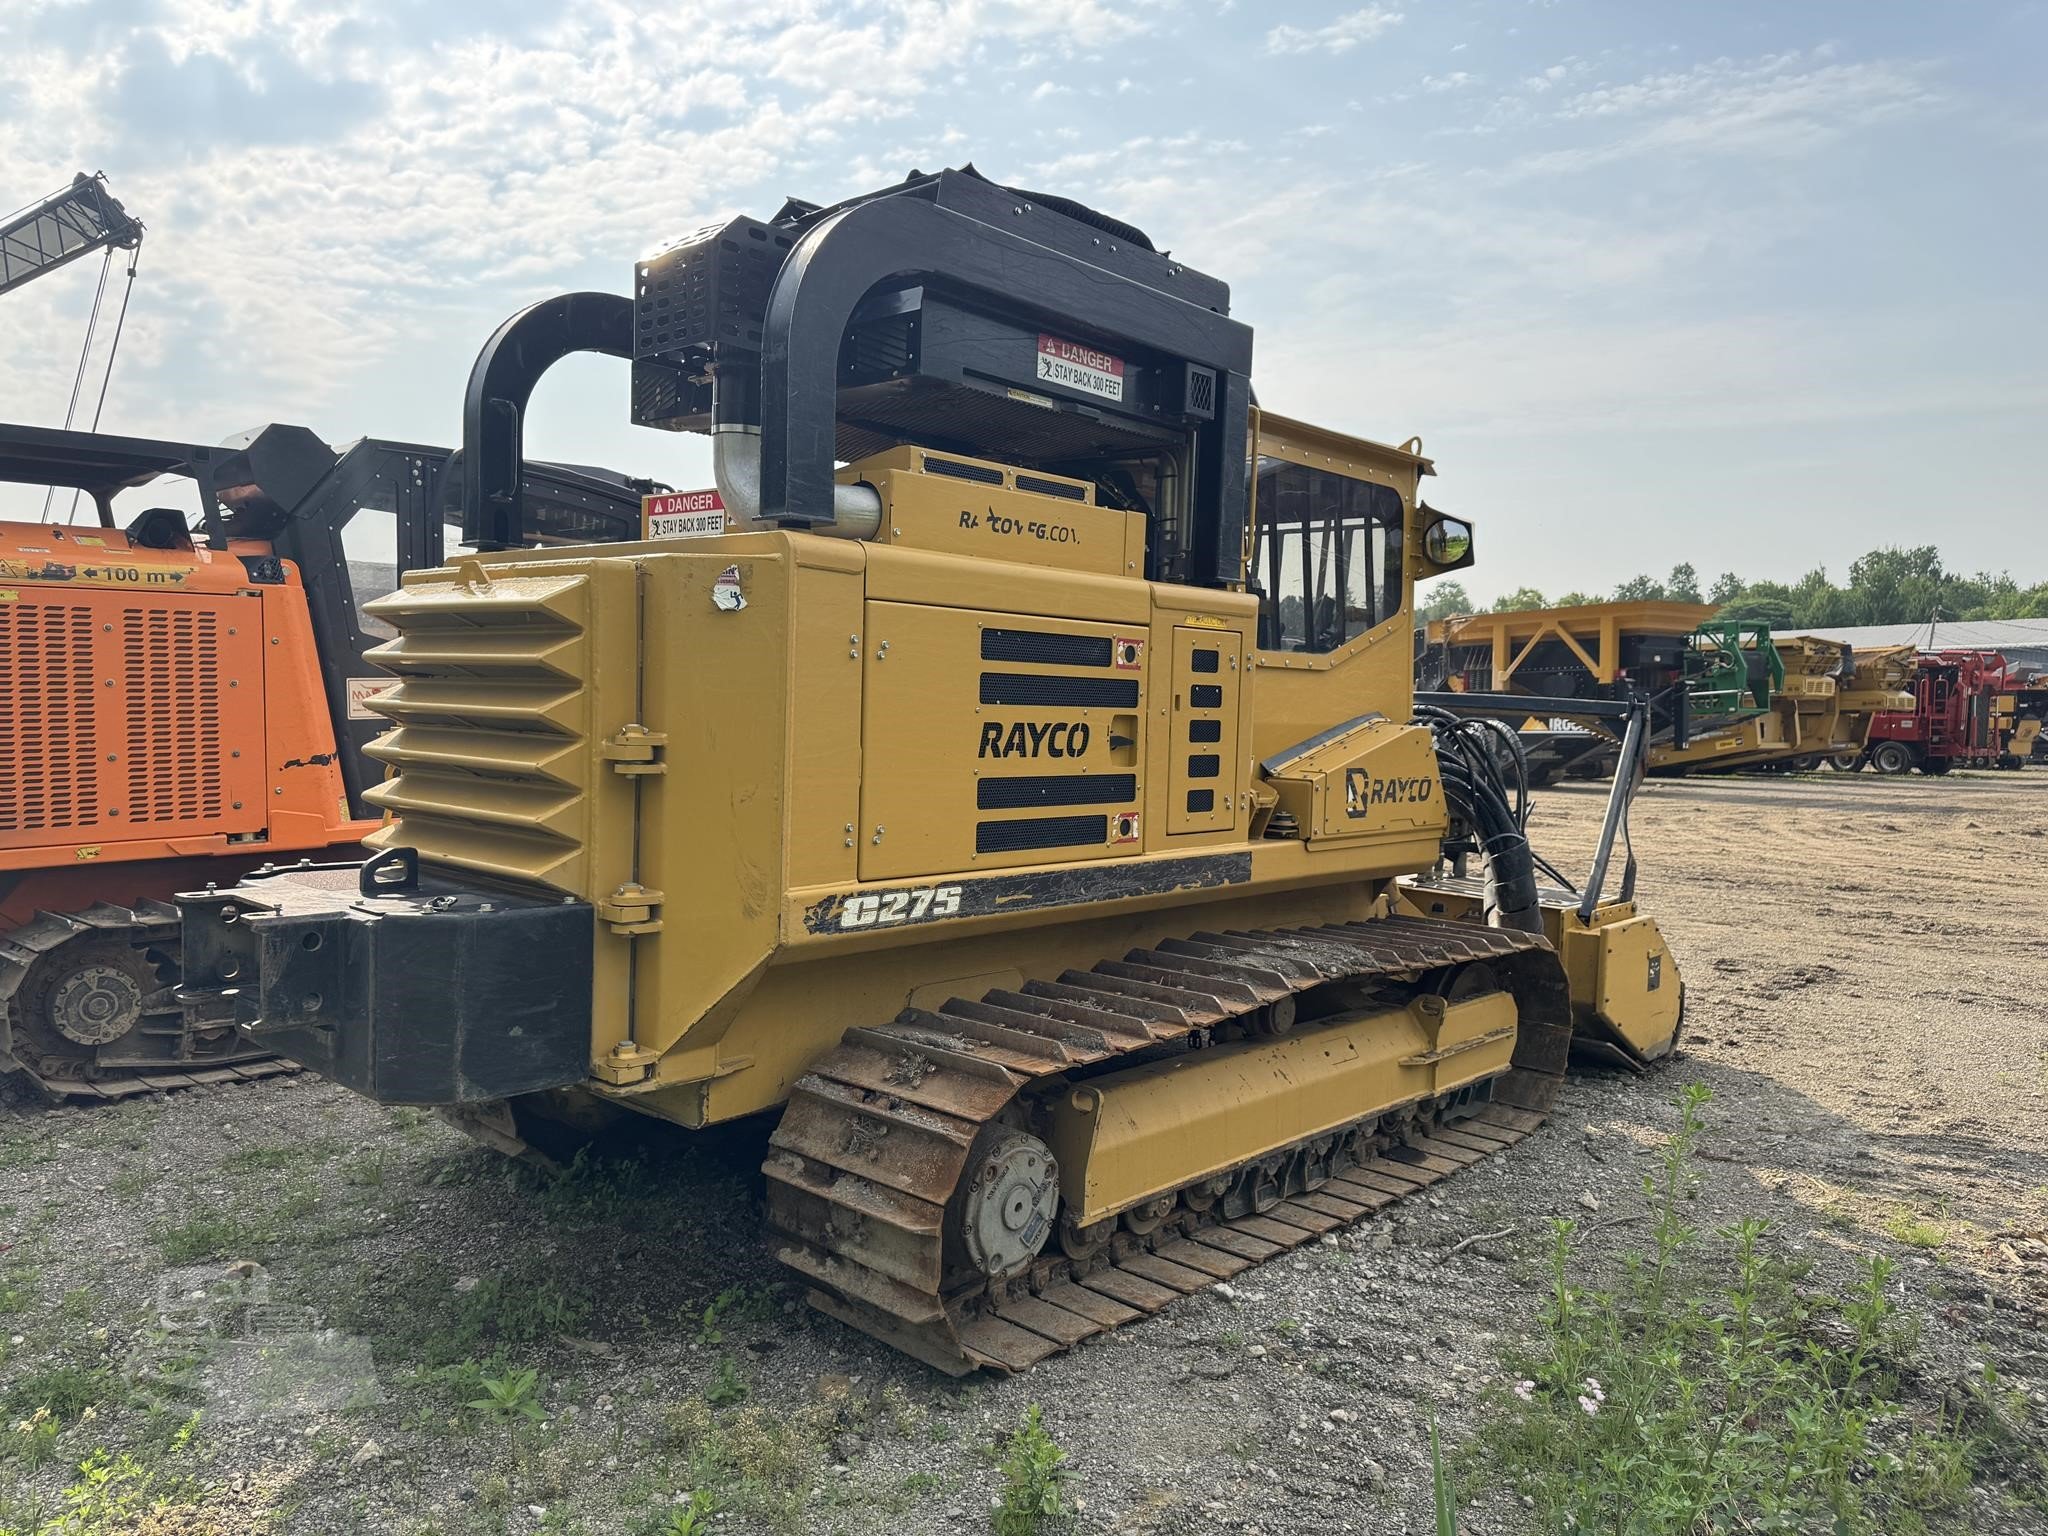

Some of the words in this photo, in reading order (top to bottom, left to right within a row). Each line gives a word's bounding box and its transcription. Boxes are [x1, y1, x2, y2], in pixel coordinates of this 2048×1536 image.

[1061, 343, 1112, 372] DANGER
[1054, 363, 1073, 382] STAY
[1073, 369, 1092, 388] BACK
[1092, 376, 1104, 392] 300
[1104, 379, 1121, 396] FEET
[667, 494, 713, 513] DANGER
[662, 518, 678, 535] STAY
[678, 517, 695, 533] BACK
[695, 516, 707, 532] 300
[706, 515, 723, 531] FEET
[102, 567, 139, 583] 100
[147, 572, 165, 583] m
[977, 721, 1091, 759] RAYCO
[1370, 776, 1432, 805] RAYCO
[840, 886, 963, 928] C275
